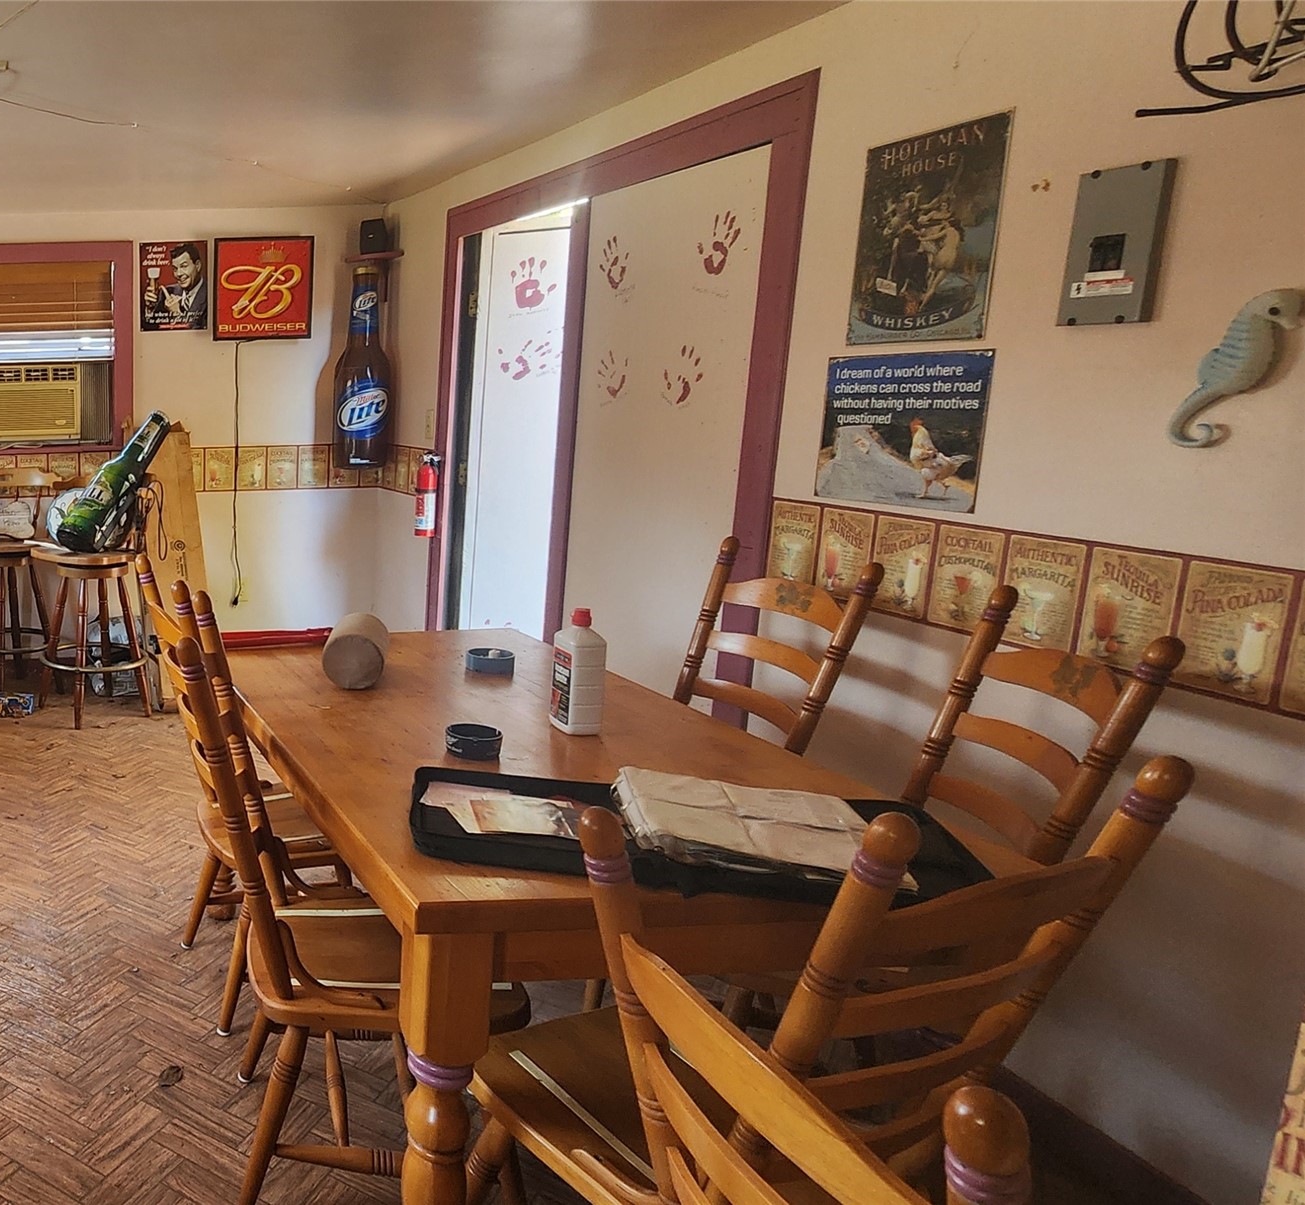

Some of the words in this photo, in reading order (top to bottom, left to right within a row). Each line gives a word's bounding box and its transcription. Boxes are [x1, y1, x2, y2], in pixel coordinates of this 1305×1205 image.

[881, 124, 988, 171] HOFFMAN
[902, 152, 957, 177] HOUSE
[218, 322, 307, 333] BUDWEISER
[872, 307, 954, 330] WHISKEY
[841, 368, 873, 379] dream
[873, 366, 885, 379] of
[885, 369, 892, 378] a
[894, 365, 925, 378] world
[926, 364, 964, 376] where
[834, 382, 877, 394] chickens
[879, 384, 898, 394] can
[899, 383, 931, 393] cross
[932, 381, 952, 393] the
[953, 380, 982, 392] road
[346, 398, 386, 427] Lite
[833, 397, 870, 409] without
[871, 397, 903, 412] having
[905, 397, 932, 409] their
[933, 397, 980, 410] motives
[837, 412, 892, 425] questioned
[830, 518, 865, 550] SUNRISE
[945, 535, 994, 553] COCKTAIL
[1014, 547, 1077, 568] AUTHENTIC
[1010, 566, 1076, 588] MARGARITA
[1117, 555, 1163, 589] TEQUILA
[1102, 561, 1164, 607] SUNRISE
[1228, 587, 1286, 610] COLADA
